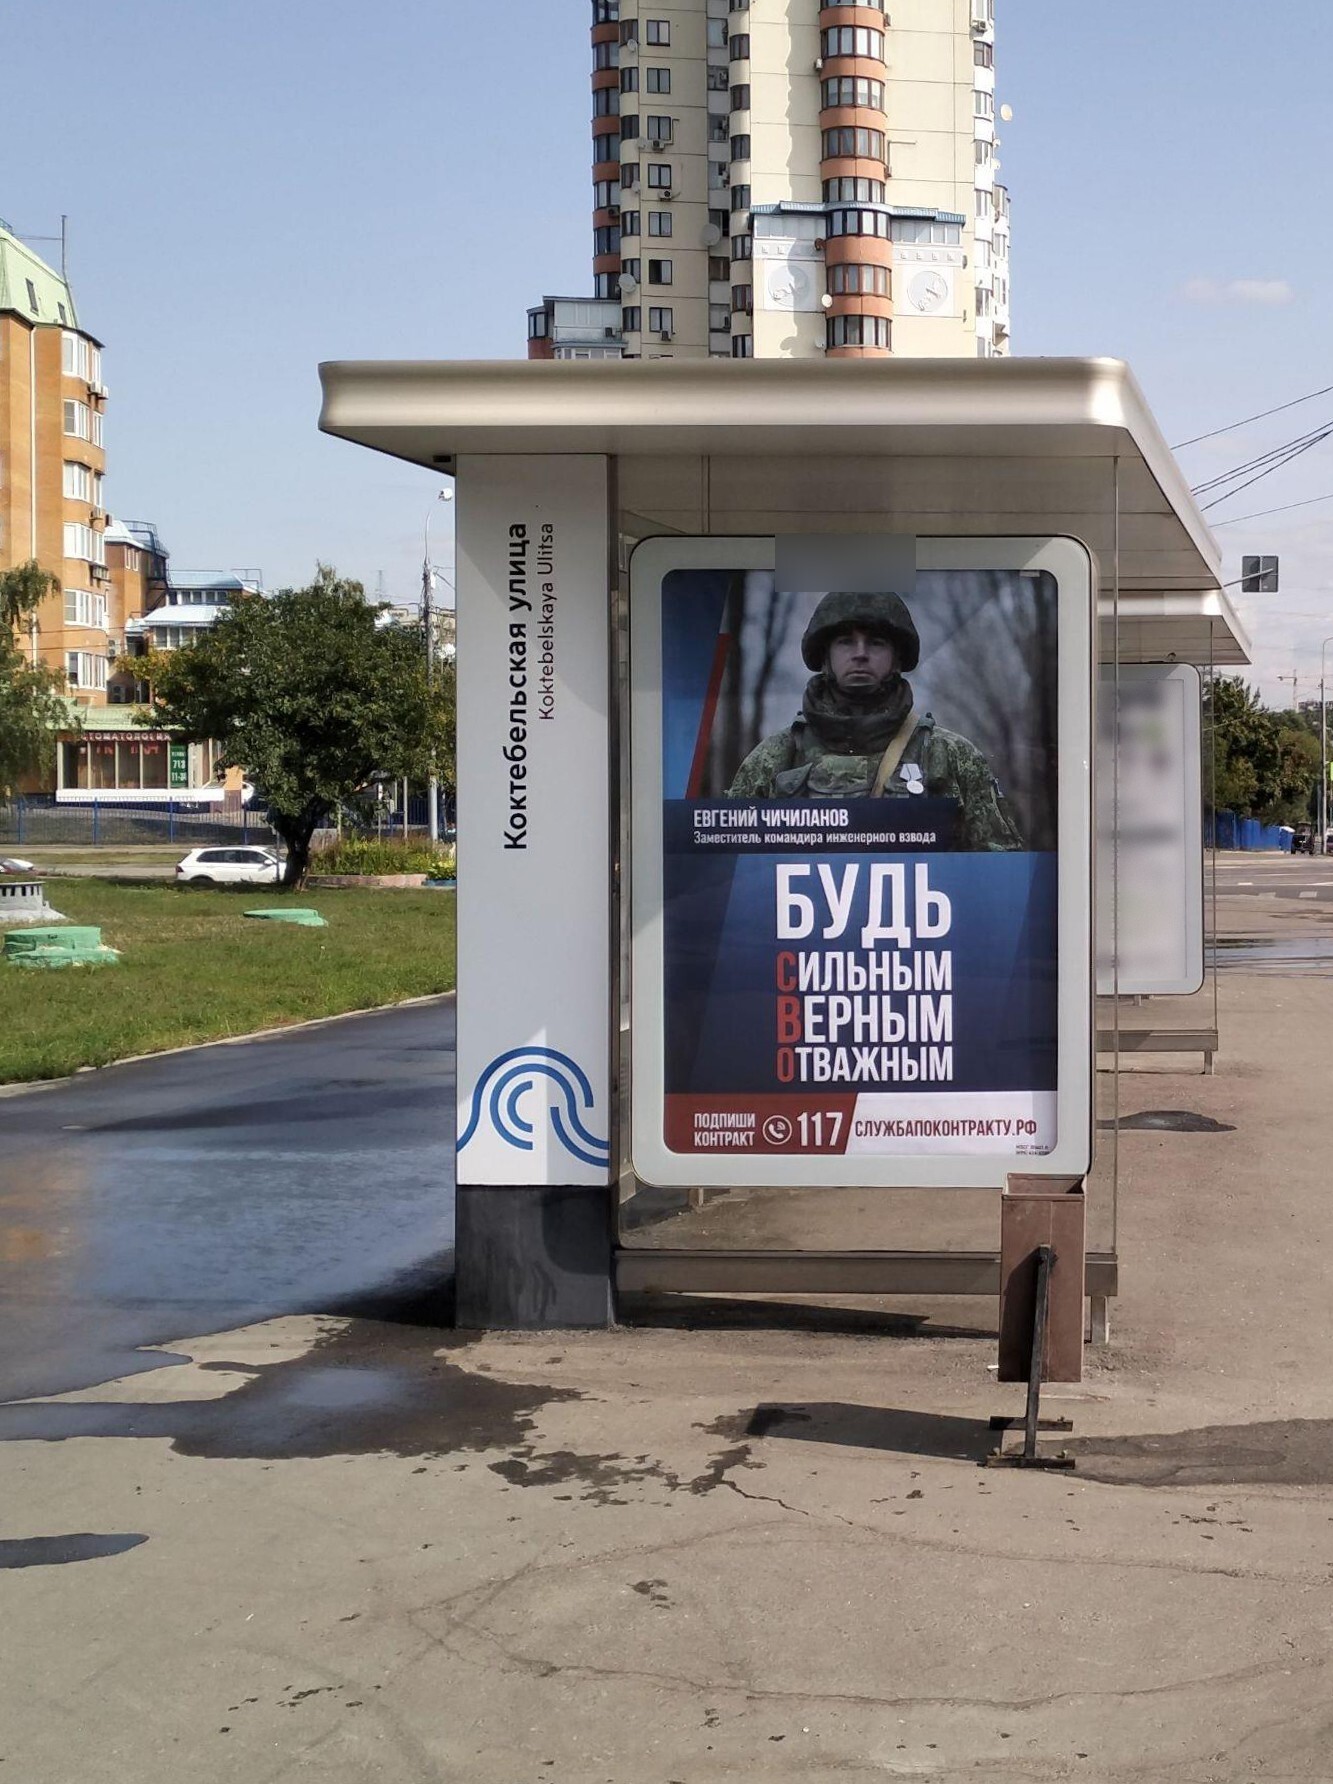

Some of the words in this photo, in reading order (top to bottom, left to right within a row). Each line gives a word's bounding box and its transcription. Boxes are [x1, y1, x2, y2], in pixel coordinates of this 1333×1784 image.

[508, 523, 533, 612] улица
[537, 522, 554, 575] Ulitsa
[537, 581, 558, 720] Koktebelskaya
[502, 622, 527, 850] Коктебельская
[693, 806, 759, 828] ЕВГЕНИЙ
[760, 808, 850, 828] ЧИЧИЛАНОВ
[693, 830, 762, 844] Заместитель
[763, 832, 824, 845] командира
[825, 832, 896, 845] инженерного
[898, 831, 937, 844] взвода
[775, 862, 953, 949] БУДЬ
[775, 950, 953, 993] СИЛЬНЫМ
[775, 994, 954, 1044] ВЕРНЫМ
[776, 1045, 954, 1083] ОТВАЖНЫМ
[693, 1112, 756, 1131] ПОДПИШИ
[693, 1131, 756, 1148] КОНТРАКТ
[796, 1111, 844, 1148] 117
[854, 1118, 1038, 1138] СЛУЖБАПОКОНТРАКТУ.РФ
